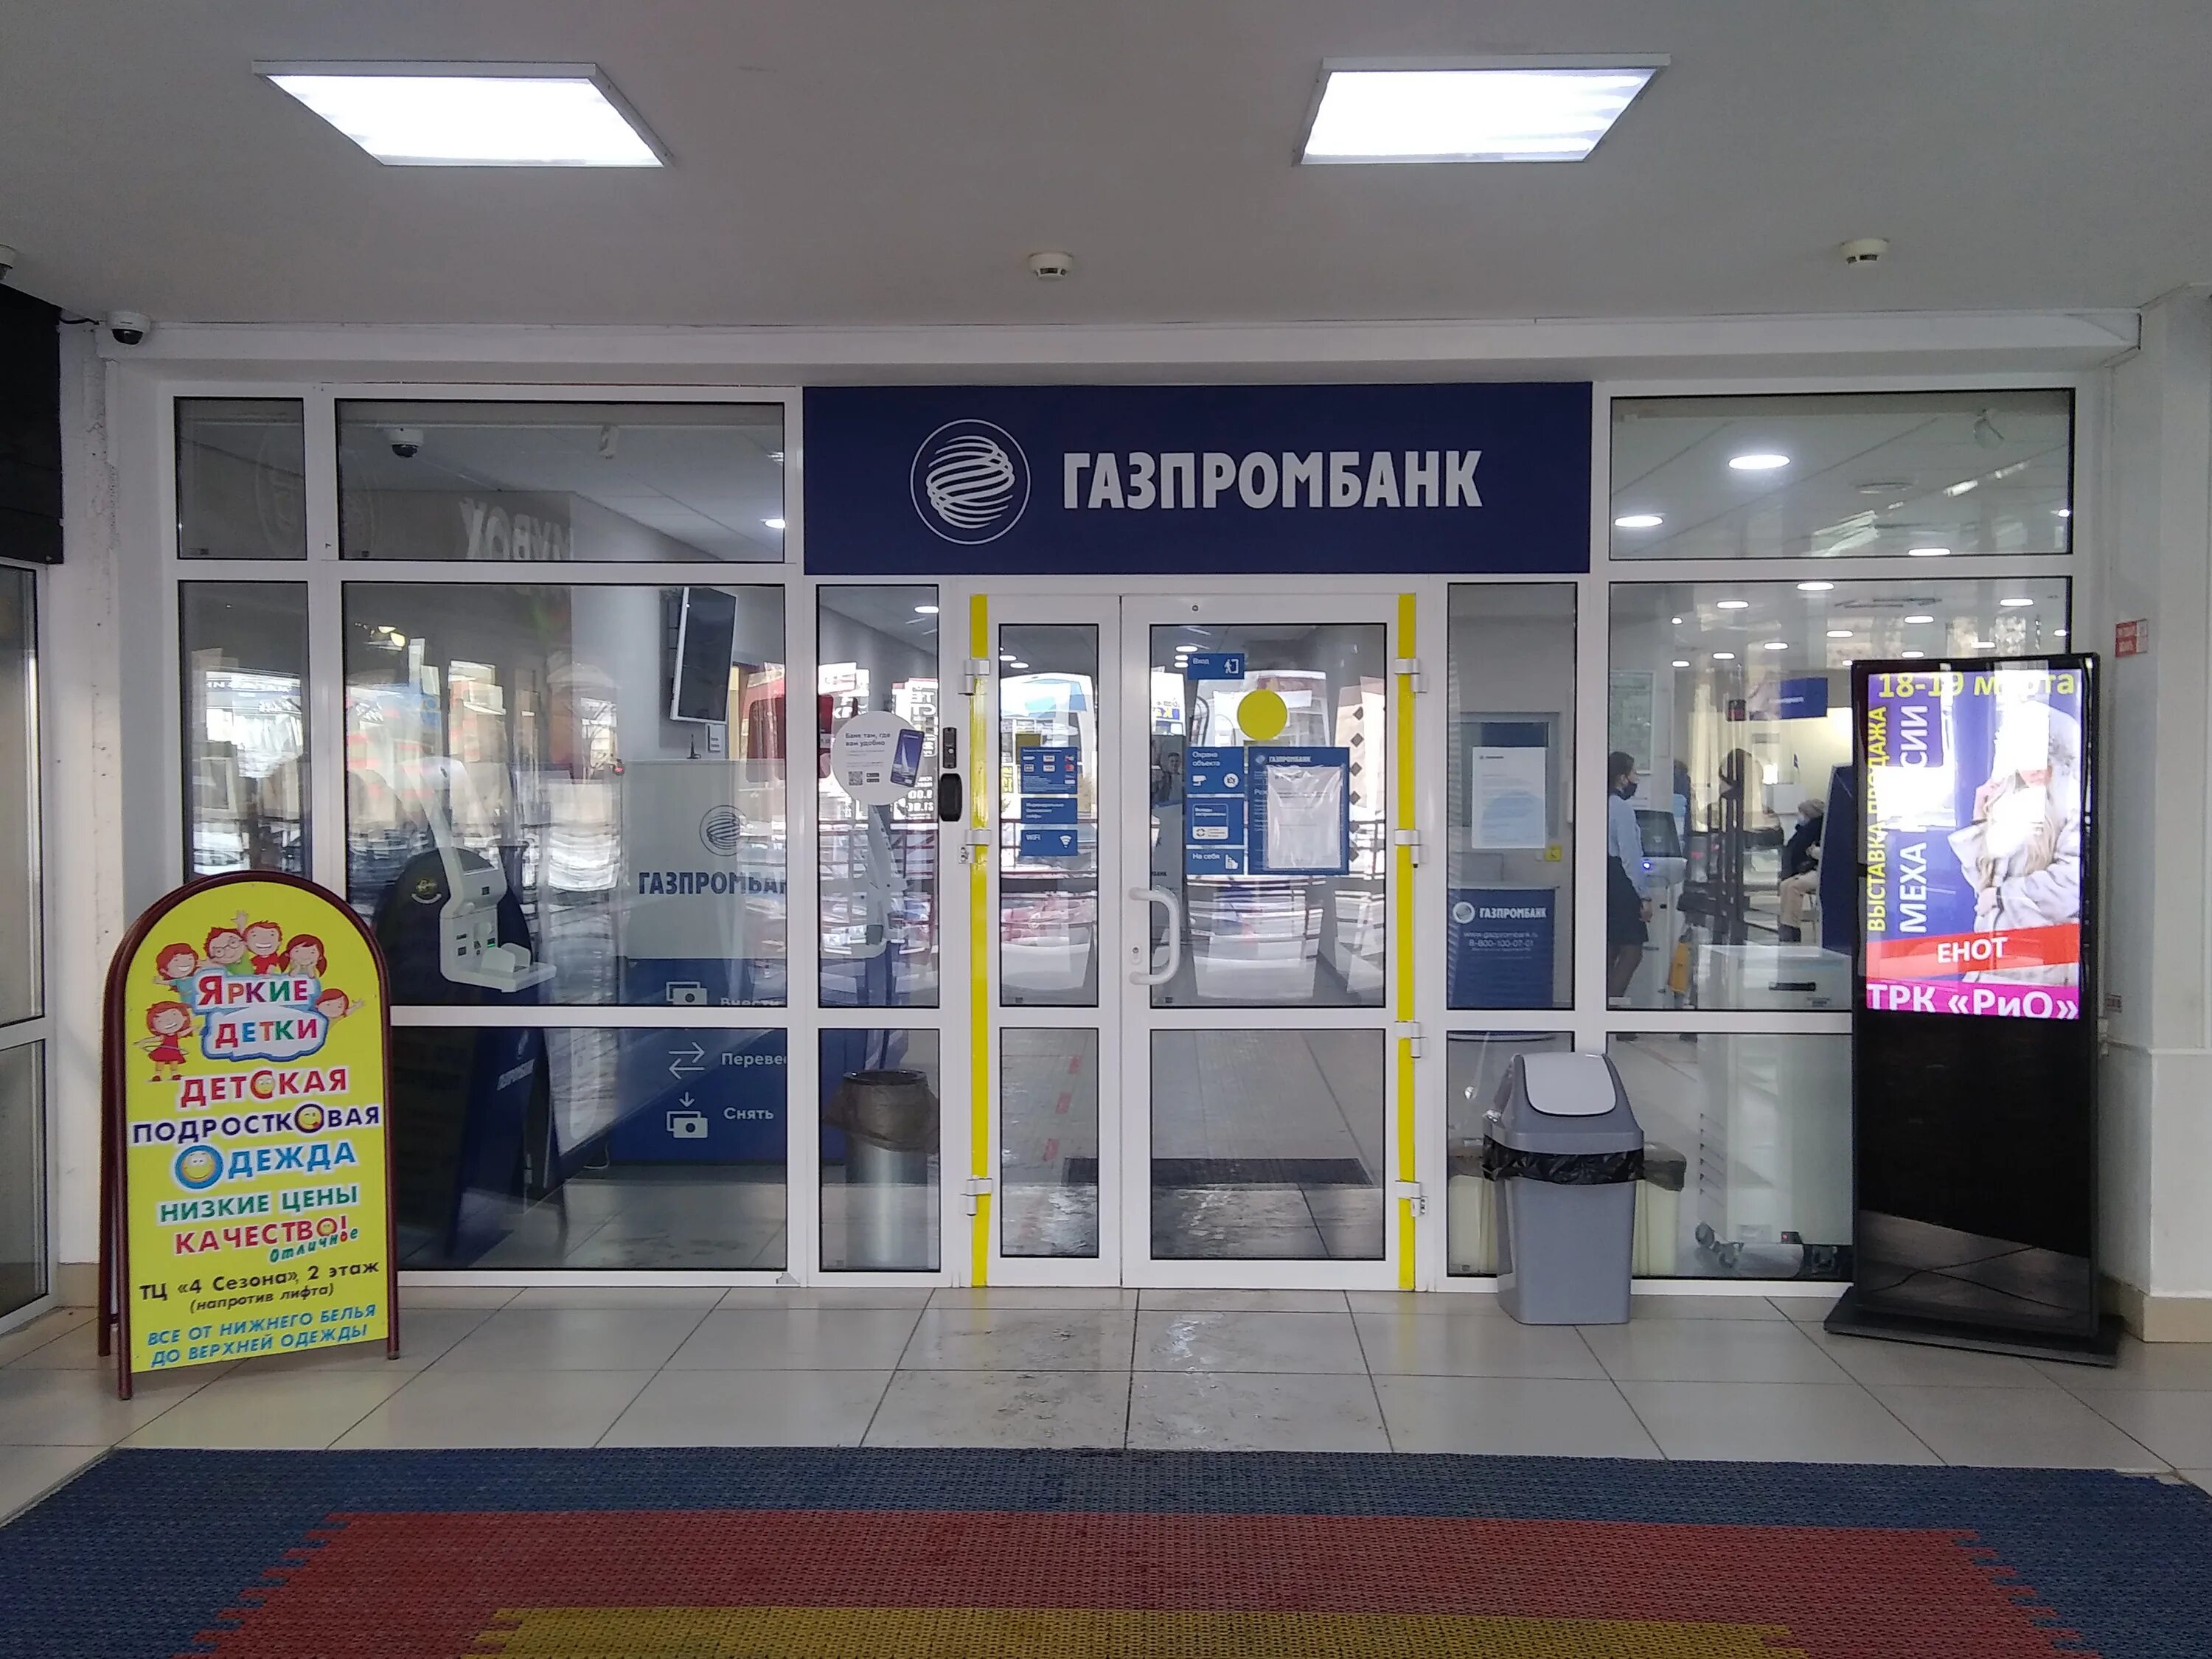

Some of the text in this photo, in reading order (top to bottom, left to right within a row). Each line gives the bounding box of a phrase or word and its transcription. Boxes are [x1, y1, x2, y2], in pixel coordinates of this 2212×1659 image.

[1063, 450, 1484, 509] ГАЗПРОМБАНК
[1193, 658, 1210, 666] Вход
[1973, 672, 2075, 697] мта
[1192, 751, 1218, 759] Охрана
[1899, 842, 1927, 933] МЕХА
[1479, 908, 1547, 919] ГАЗПРОМБАНК
[1936, 936, 2008, 964] ЕНОТ
[198, 975, 309, 1006] ЯРКИЕ
[1866, 984, 2079, 1020] ТРК «РиО»
[215, 1019, 318, 1048] ДЕТКИ
[181, 1068, 347, 1108] ДЕТСКАЯ
[133, 1103, 380, 1144] ПОДРОСТКОВАЯ
[723, 1107, 773, 1120] Снять
[175, 1142, 355, 1189] ОДЕЖДА
[160, 1186, 358, 1222] НИЗКИЕ ЦЕНЫ
[175, 1215, 347, 1255] КАЧЕСТВО!
[139, 1283, 168, 1301] ТЦ
[178, 1279, 202, 1295] «4
[307, 1265, 319, 1281] 2
[328, 1262, 380, 1277] этаж
[190, 1283, 335, 1314] (напротив лифта)
[147, 1304, 376, 1346] ВСЕ ОТ НИЖНЕГО БЕЛЬЯ
[151, 1324, 368, 1368] ДО ВЕРХНЕЙ ОДЕЖДЫ
